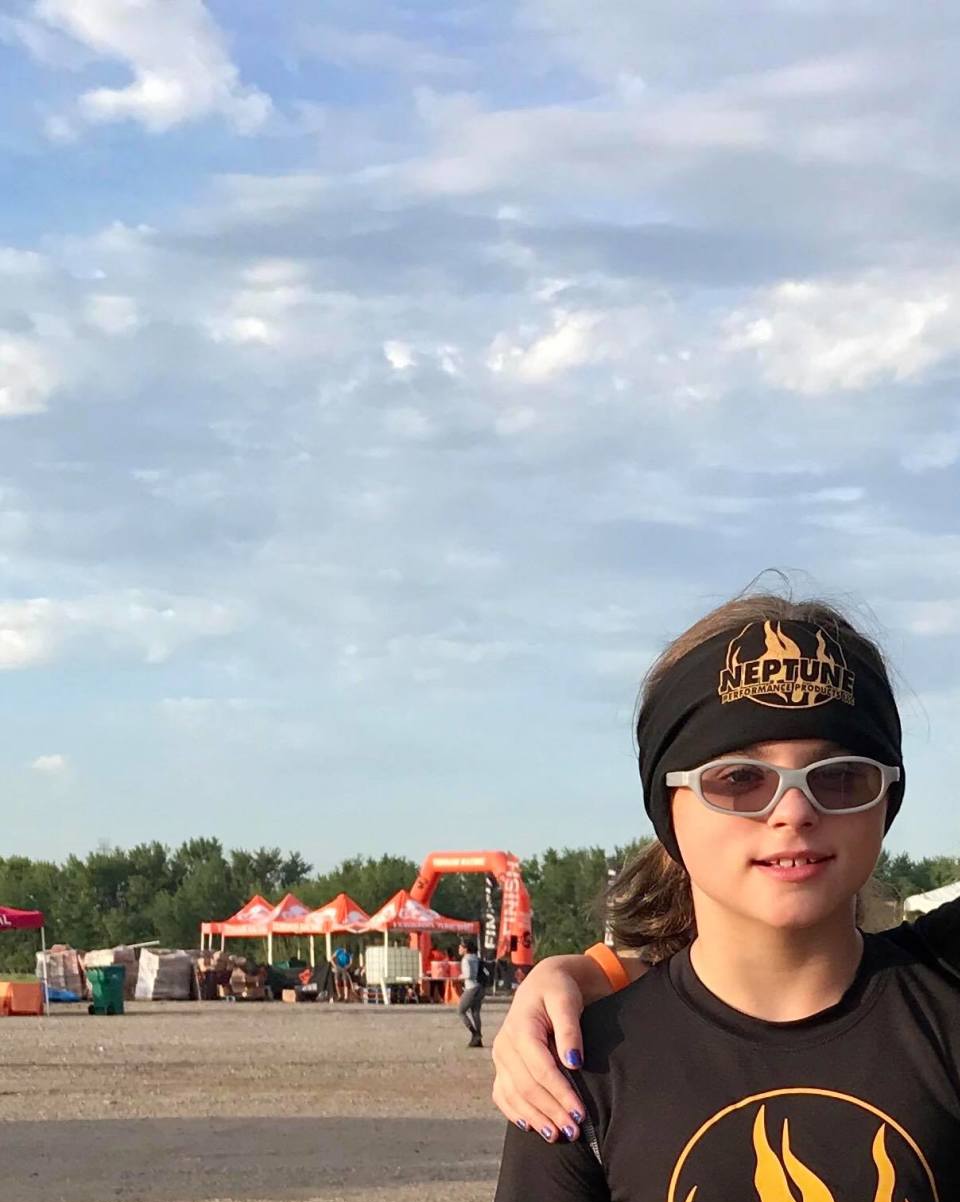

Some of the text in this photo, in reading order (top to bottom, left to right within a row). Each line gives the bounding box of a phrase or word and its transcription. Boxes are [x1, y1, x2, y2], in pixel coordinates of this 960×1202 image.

[719, 657, 856, 695] NEPTUNE
[721, 682, 792, 705] PERFORMANCE
[484, 876, 497, 949] FIN
